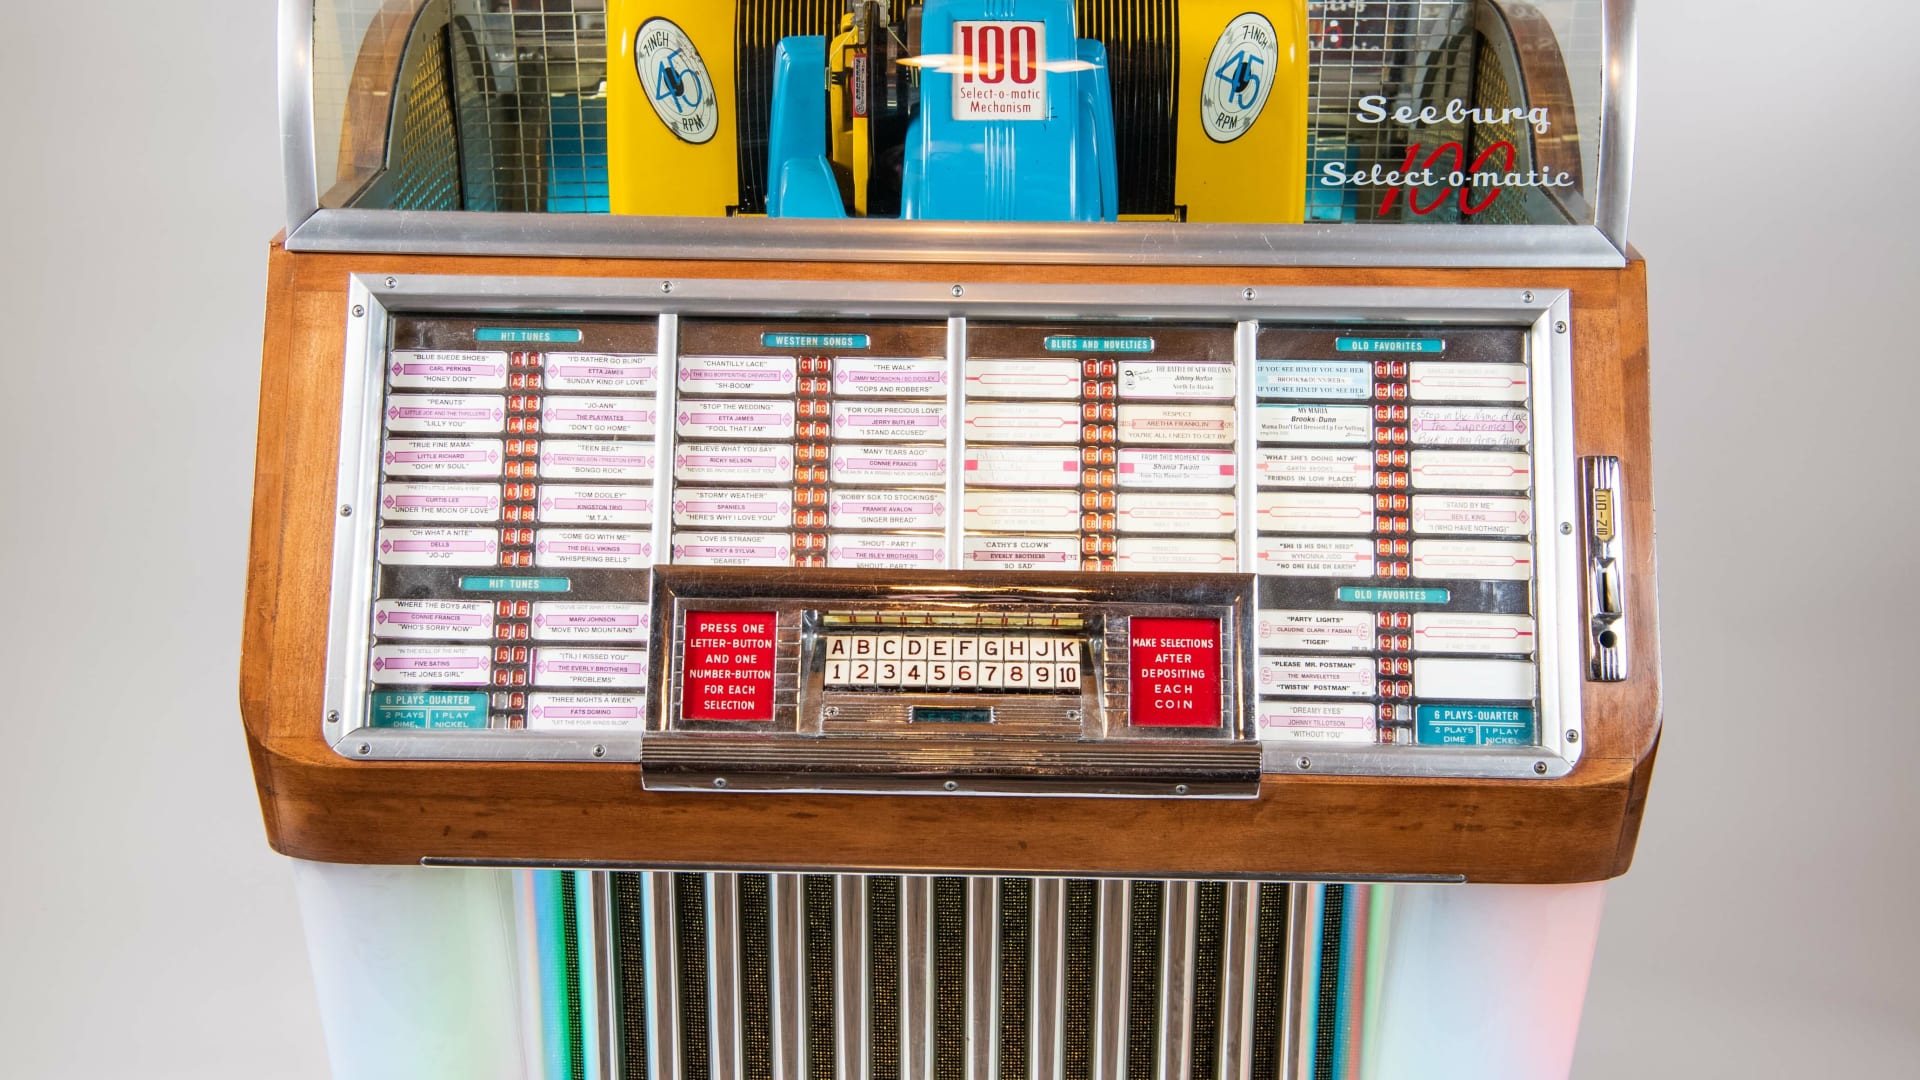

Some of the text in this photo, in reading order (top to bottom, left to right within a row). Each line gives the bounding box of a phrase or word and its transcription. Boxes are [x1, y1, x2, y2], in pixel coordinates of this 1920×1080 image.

[960, 26, 1037, 84] 100
[656, 47, 702, 112] 45
[1214, 50, 1264, 110] 45
[960, 87, 1040, 99] Select-o-matic
[970, 101, 1031, 113] Mechanism
[1356, 95, 1552, 134] Seeburg
[682, 114, 704, 132] RPM
[1216, 112, 1238, 129] RPM
[1320, 161, 1574, 188] Select-o-matic
[1378, 140, 1518, 217] 100
[501, 332, 550, 342] HIT TUNES
[776, 336, 853, 346] WESTERN SONGS
[1051, 339, 1148, 349] BLUES AND NOVELTIES
[1352, 341, 1422, 351] OLD FAVORITES
[801, 361, 811, 369] C1
[1378, 366, 1387, 374] G1
[816, 383, 827, 391] D2
[1086, 386, 1096, 395] E2
[1377, 388, 1388, 397] G2
[1394, 388, 1404, 397] H2
[1102, 408, 1112, 417] F3
[489, 579, 540, 589] HIT TUNES
[1354, 590, 1426, 600] OLD FAVORITES
[502, 606, 510, 614] J1
[518, 606, 527, 614] J5
[1398, 616, 1407, 625] K7
[700, 623, 765, 634] PRESS ONE
[690, 638, 772, 649] LETTER-BUTTON
[832, 640, 1074, 656] A B C D E F G H J K
[1132, 638, 1214, 649] MAKE SELECTIONS
[516, 651, 524, 660] J7
[705, 654, 757, 664] AND ONE
[1154, 653, 1192, 663] AFTER
[689, 669, 771, 679] NUMBER-BUTTON
[833, 664, 1076, 682] 1 2 3 4 5 6 7 8 9 10
[1141, 668, 1205, 679] DEPOSITING
[704, 684, 756, 694] FOR EACH
[1154, 684, 1193, 694] EACH
[386, 696, 391, 704] 6
[704, 700, 755, 710] SELECTION
[1154, 699, 1193, 709] COIN
[442, 710, 469, 719] PLAY
[1434, 711, 1440, 720] 6
